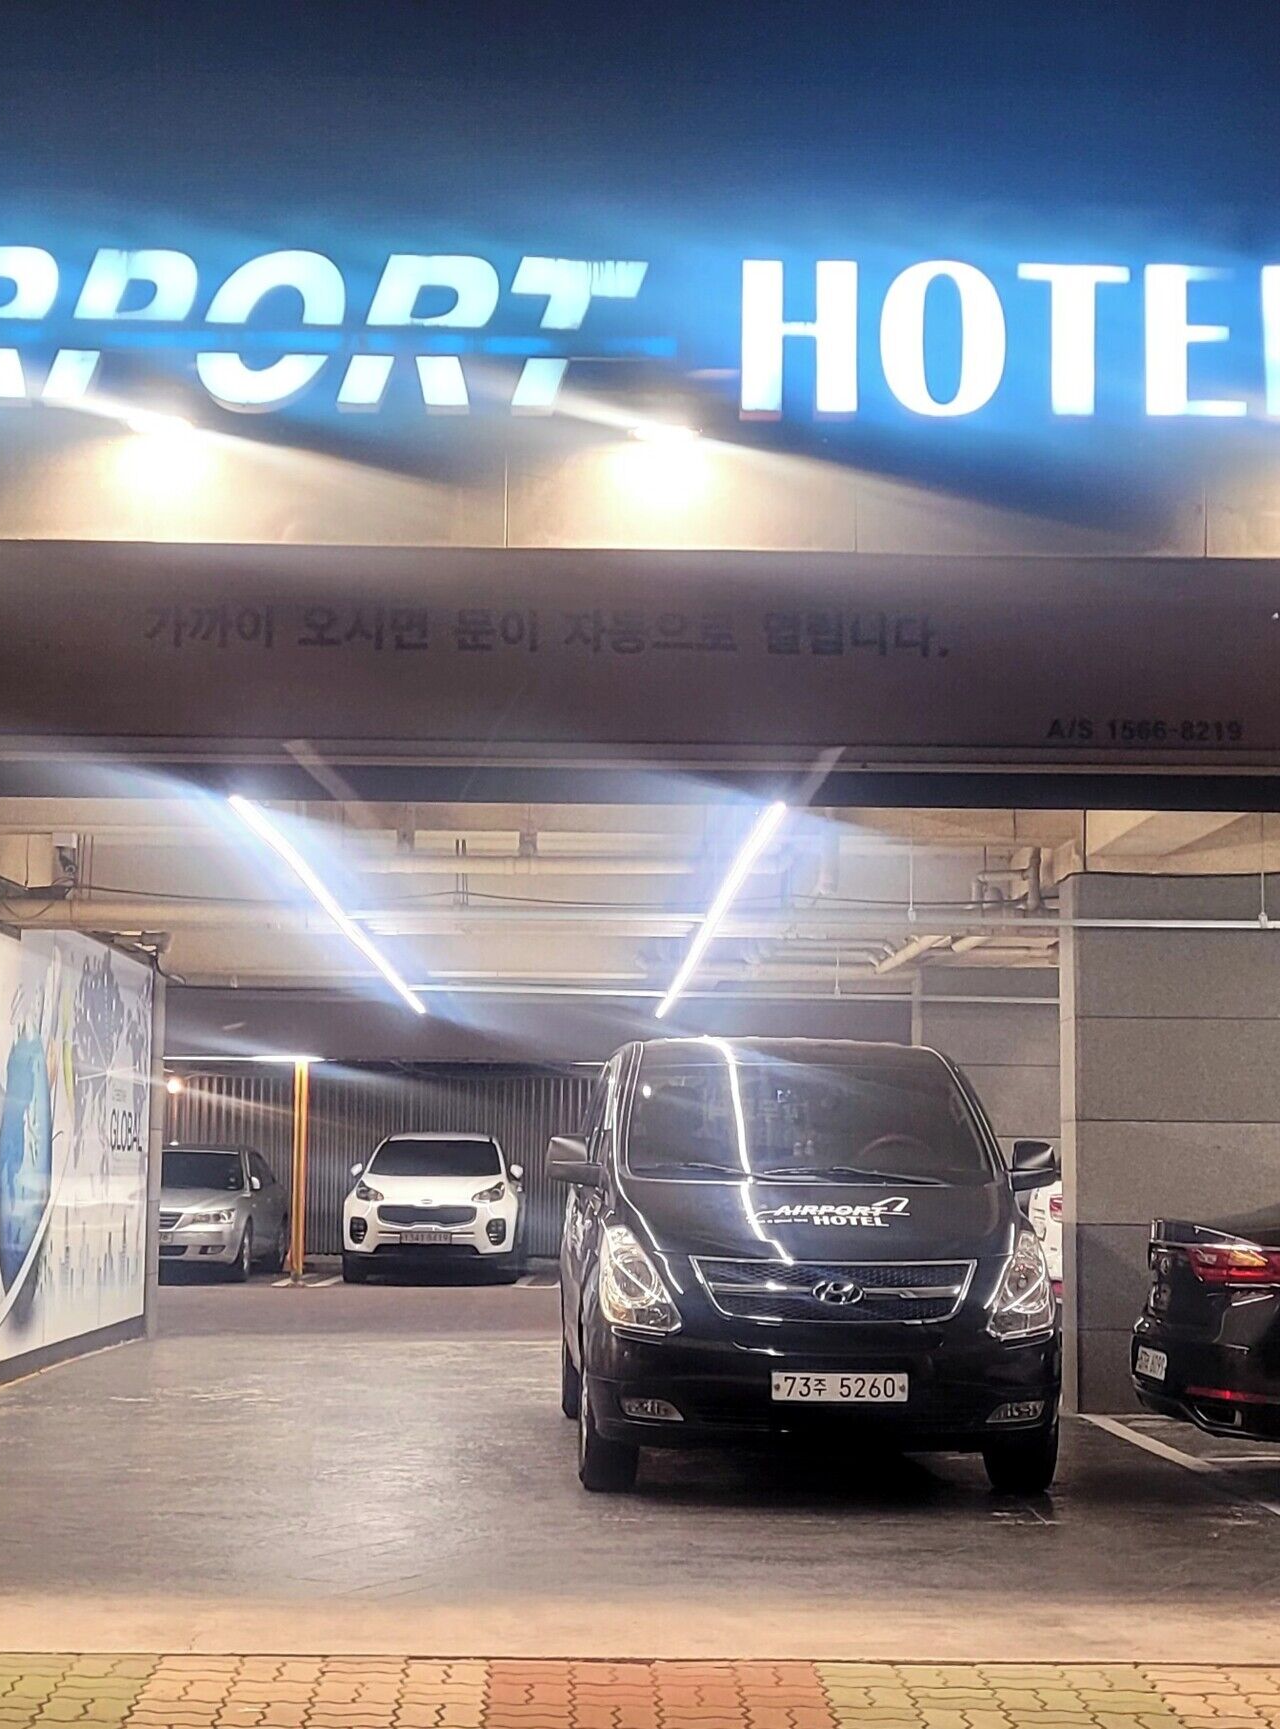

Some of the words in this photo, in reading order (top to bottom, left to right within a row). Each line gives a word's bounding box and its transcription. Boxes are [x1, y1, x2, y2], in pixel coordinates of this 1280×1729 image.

[143, 606, 274, 650] 가까이
[297, 606, 429, 651] 오시면
[456, 608, 539, 653] 문이
[564, 609, 738, 655] 자동으로
[1046, 718, 1094, 740] A/S
[110, 1109, 143, 1152] GLOBAL
[774, 1204, 889, 1217] AIRPORT
[813, 1215, 890, 1227] HOTEL
[783, 1376, 828, 1398] 73주
[838, 1376, 897, 1399] 5260
